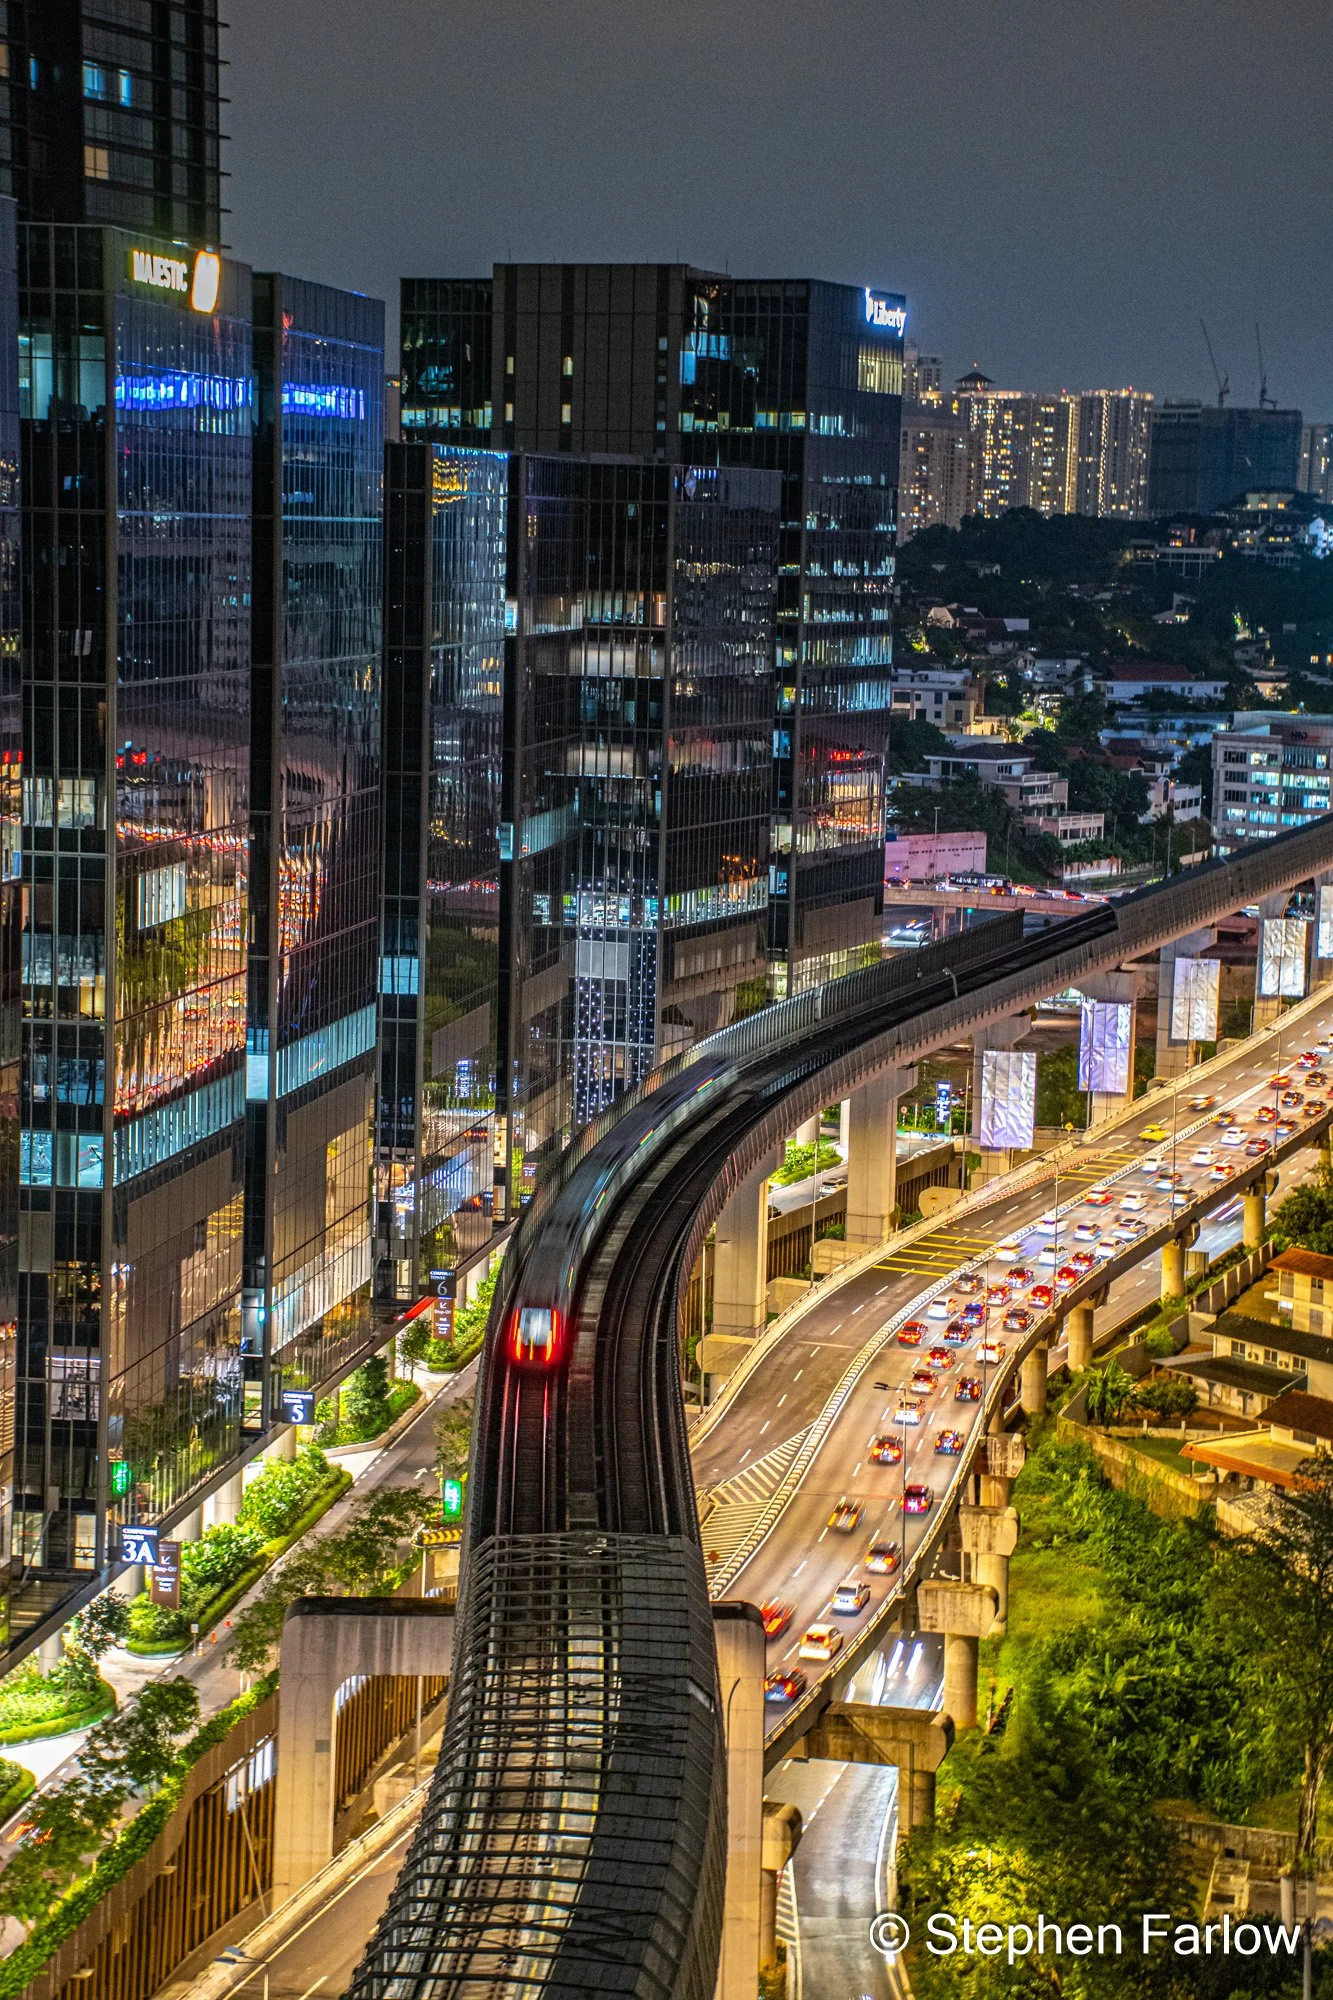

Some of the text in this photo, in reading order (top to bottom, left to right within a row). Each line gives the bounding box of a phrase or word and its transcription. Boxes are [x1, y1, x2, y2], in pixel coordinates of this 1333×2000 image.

[133, 250, 188, 292] MAJESTIC
[873, 300, 907, 338] Liberty
[437, 1280, 448, 1296] 6
[291, 1404, 304, 1423] 5
[122, 1540, 156, 1564] 3A
